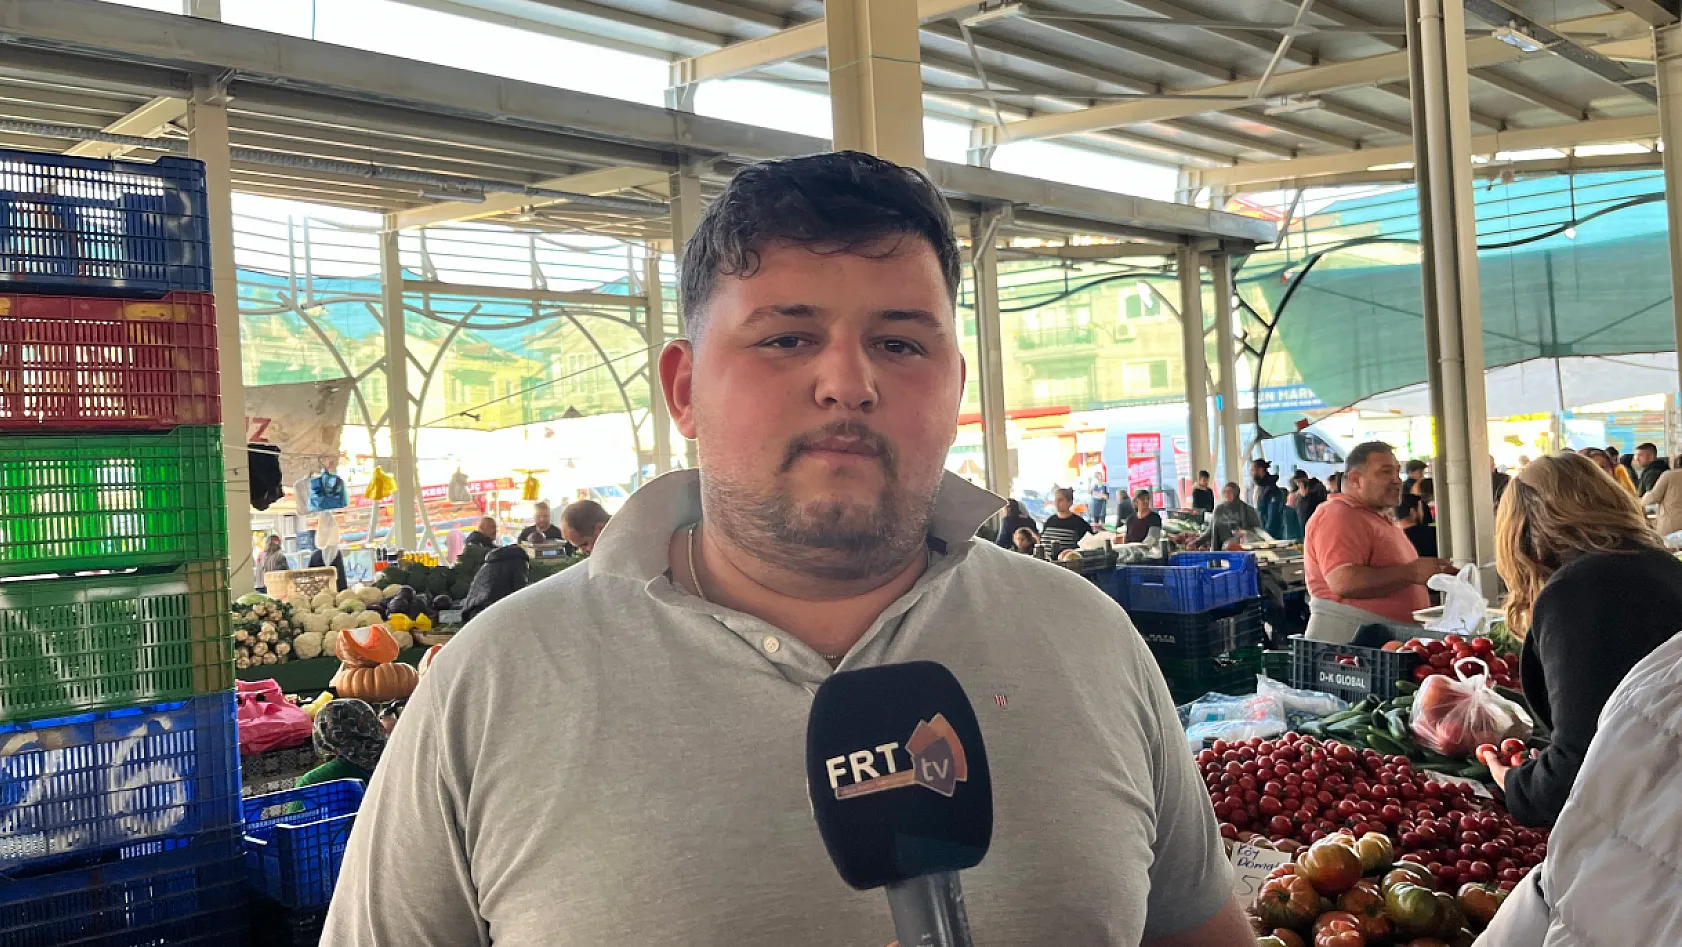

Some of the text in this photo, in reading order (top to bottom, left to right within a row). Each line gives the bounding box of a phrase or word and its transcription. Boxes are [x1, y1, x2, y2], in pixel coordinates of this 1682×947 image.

[1336, 674, 1365, 689] GLOBAL
[826, 742, 949, 789] FRT tv
